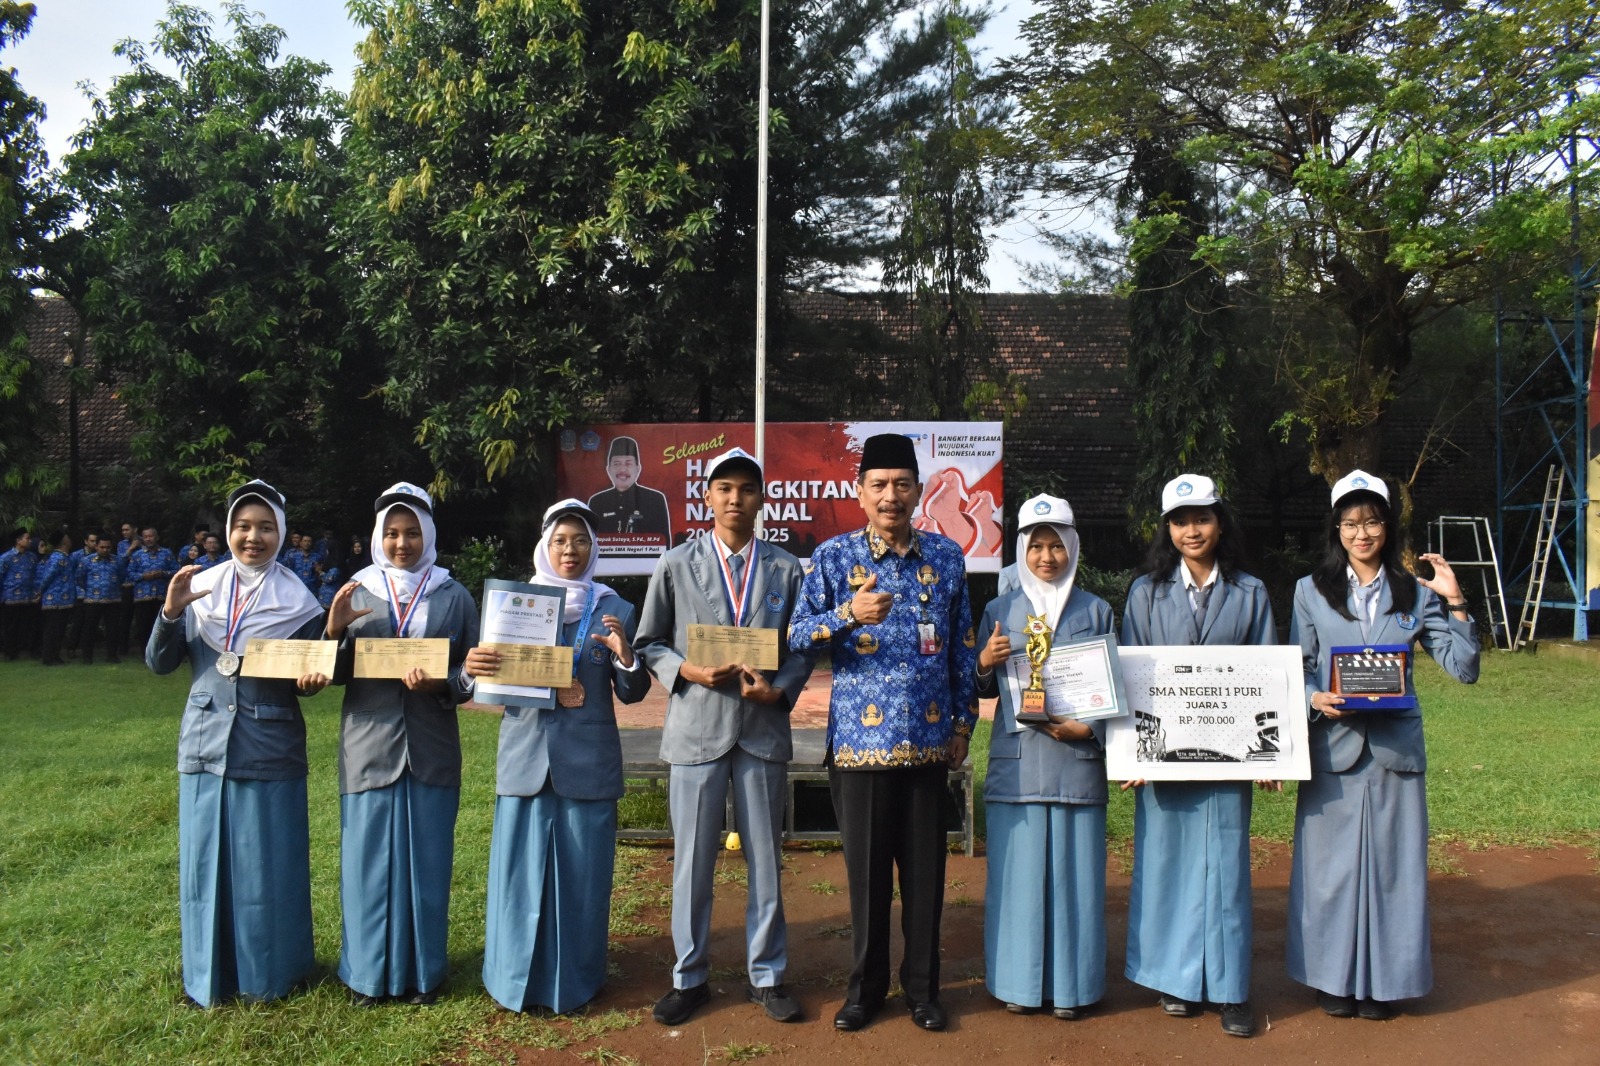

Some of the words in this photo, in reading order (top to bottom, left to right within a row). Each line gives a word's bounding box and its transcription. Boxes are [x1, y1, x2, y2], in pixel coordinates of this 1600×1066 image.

[662, 432, 725, 465] Selamat
[686, 480, 858, 499] KGKITAN
[762, 527, 790, 543] 025
[1149, 687, 1176, 697] SMA
[1179, 687, 1222, 697] NEGERI
[1226, 687, 1231, 697] 1
[1234, 687, 1262, 697] PURI
[1186, 701, 1219, 710] JUARA
[1221, 701, 1228, 710] 3
[1179, 716, 1195, 725] RP.
[1197, 716, 1235, 725] 700.000
